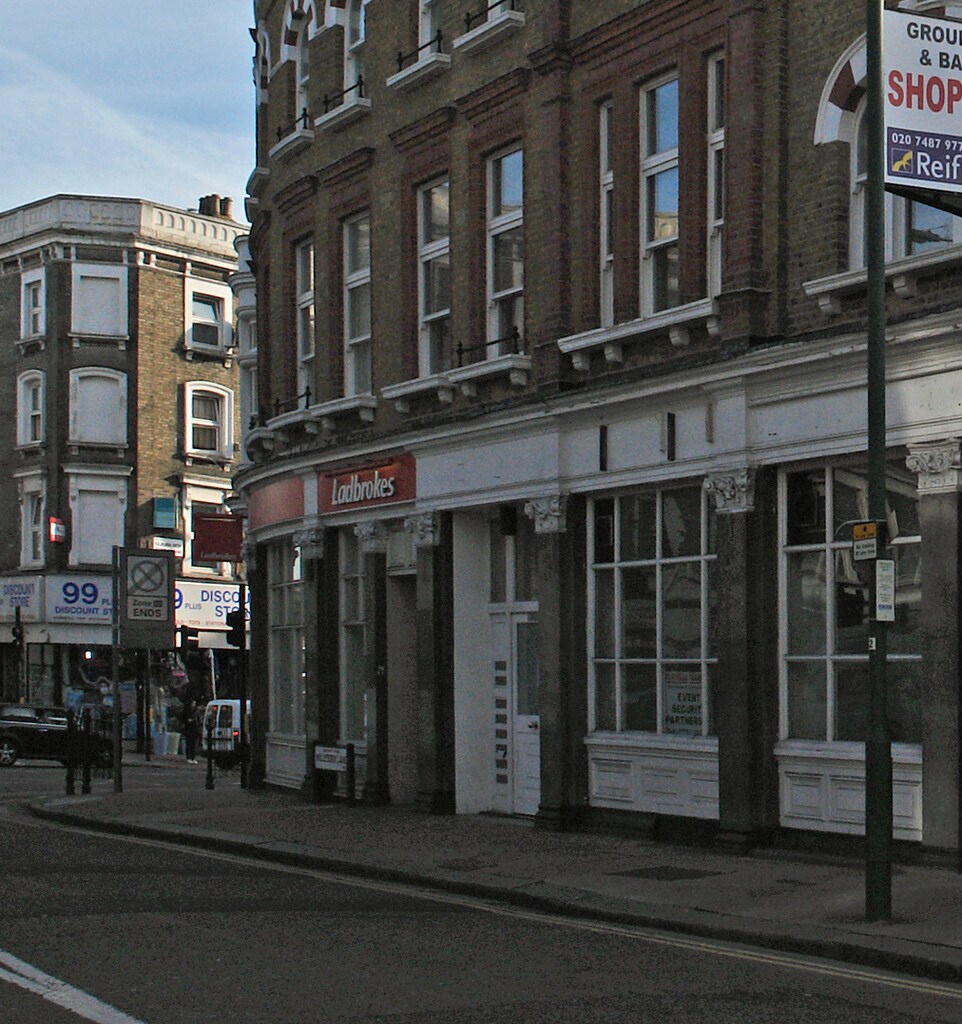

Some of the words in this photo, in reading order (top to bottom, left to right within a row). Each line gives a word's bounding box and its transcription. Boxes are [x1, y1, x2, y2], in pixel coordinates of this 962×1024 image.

[919, 49, 932, 66] &
[887, 69, 962, 114] SHOP
[891, 132, 912, 145] 020
[915, 136, 942, 149] 7487
[332, 470, 394, 506] Ladbrokes
[62, 582, 99, 605] 99
[55, 607, 99, 615] DISCOUNT
[133, 608, 162, 618] ENDS
[671, 704, 702, 714] SECURIT
